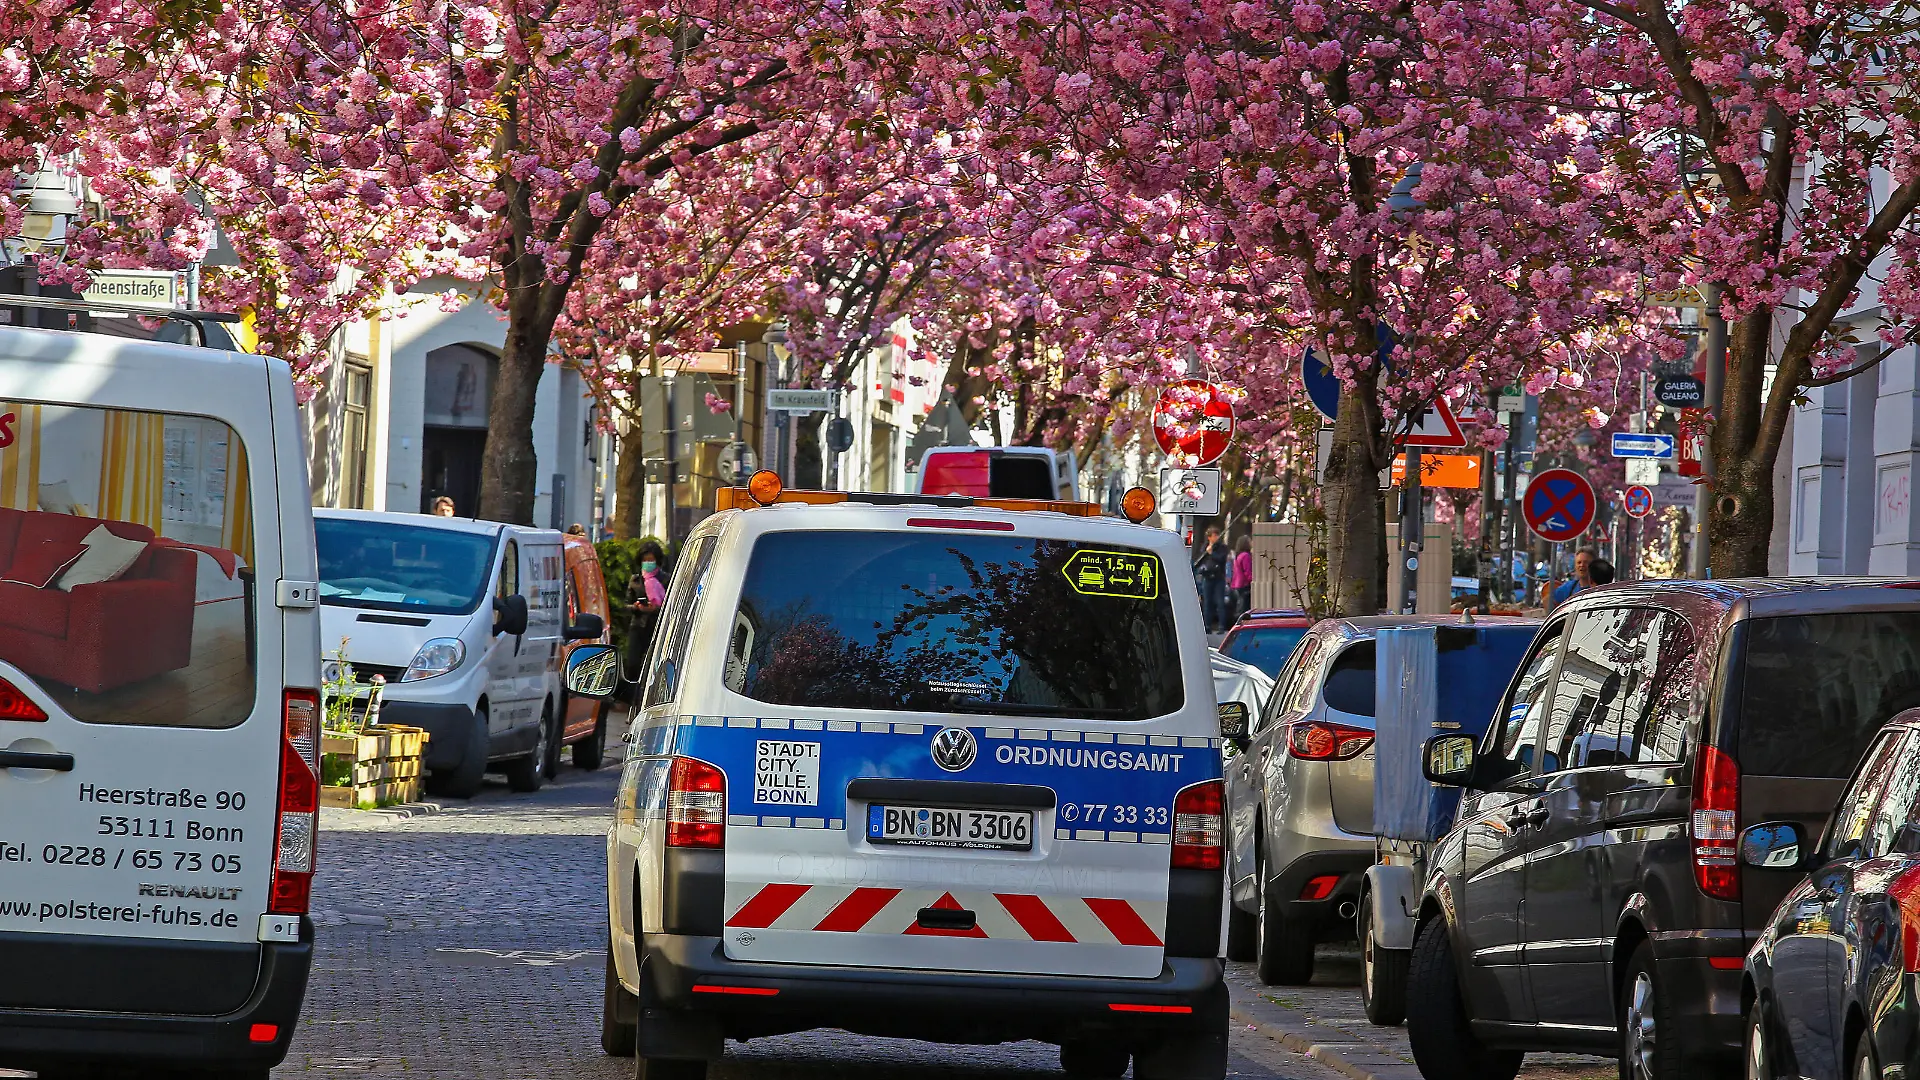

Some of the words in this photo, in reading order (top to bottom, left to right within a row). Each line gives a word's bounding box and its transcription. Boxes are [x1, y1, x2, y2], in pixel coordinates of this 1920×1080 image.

[1664, 382, 1696, 390] GALERIA
[1661, 392, 1699, 400] GALEANO
[1080, 556, 1103, 564] mind.
[1105, 557, 1124, 572] 1,5
[1125, 562, 1136, 572] m
[758, 742, 818, 757] STADT.
[995, 744, 1184, 772] ORDNUNGSAMT
[758, 757, 800, 772] CITY.
[756, 773, 811, 788] VILLE.
[79, 782, 207, 809] Heerstraße
[216, 790, 246, 811] 90
[756, 789, 812, 804] BONN.
[1083, 804, 1108, 822] 77
[1113, 805, 1138, 824] 33
[1143, 806, 1168, 825] 33
[98, 815, 175, 839] 53111
[186, 820, 243, 843] Bonn
[885, 809, 916, 835] BN
[931, 811, 962, 838] BN
[968, 813, 1027, 841] 3306
[0, 841, 32, 863] Tel.
[42, 844, 106, 867] 0228
[113, 848, 125, 870] /
[132, 849, 163, 870] 65
[173, 851, 202, 872] 73
[211, 853, 242, 874] 05
[139, 882, 242, 900] RENAULT
